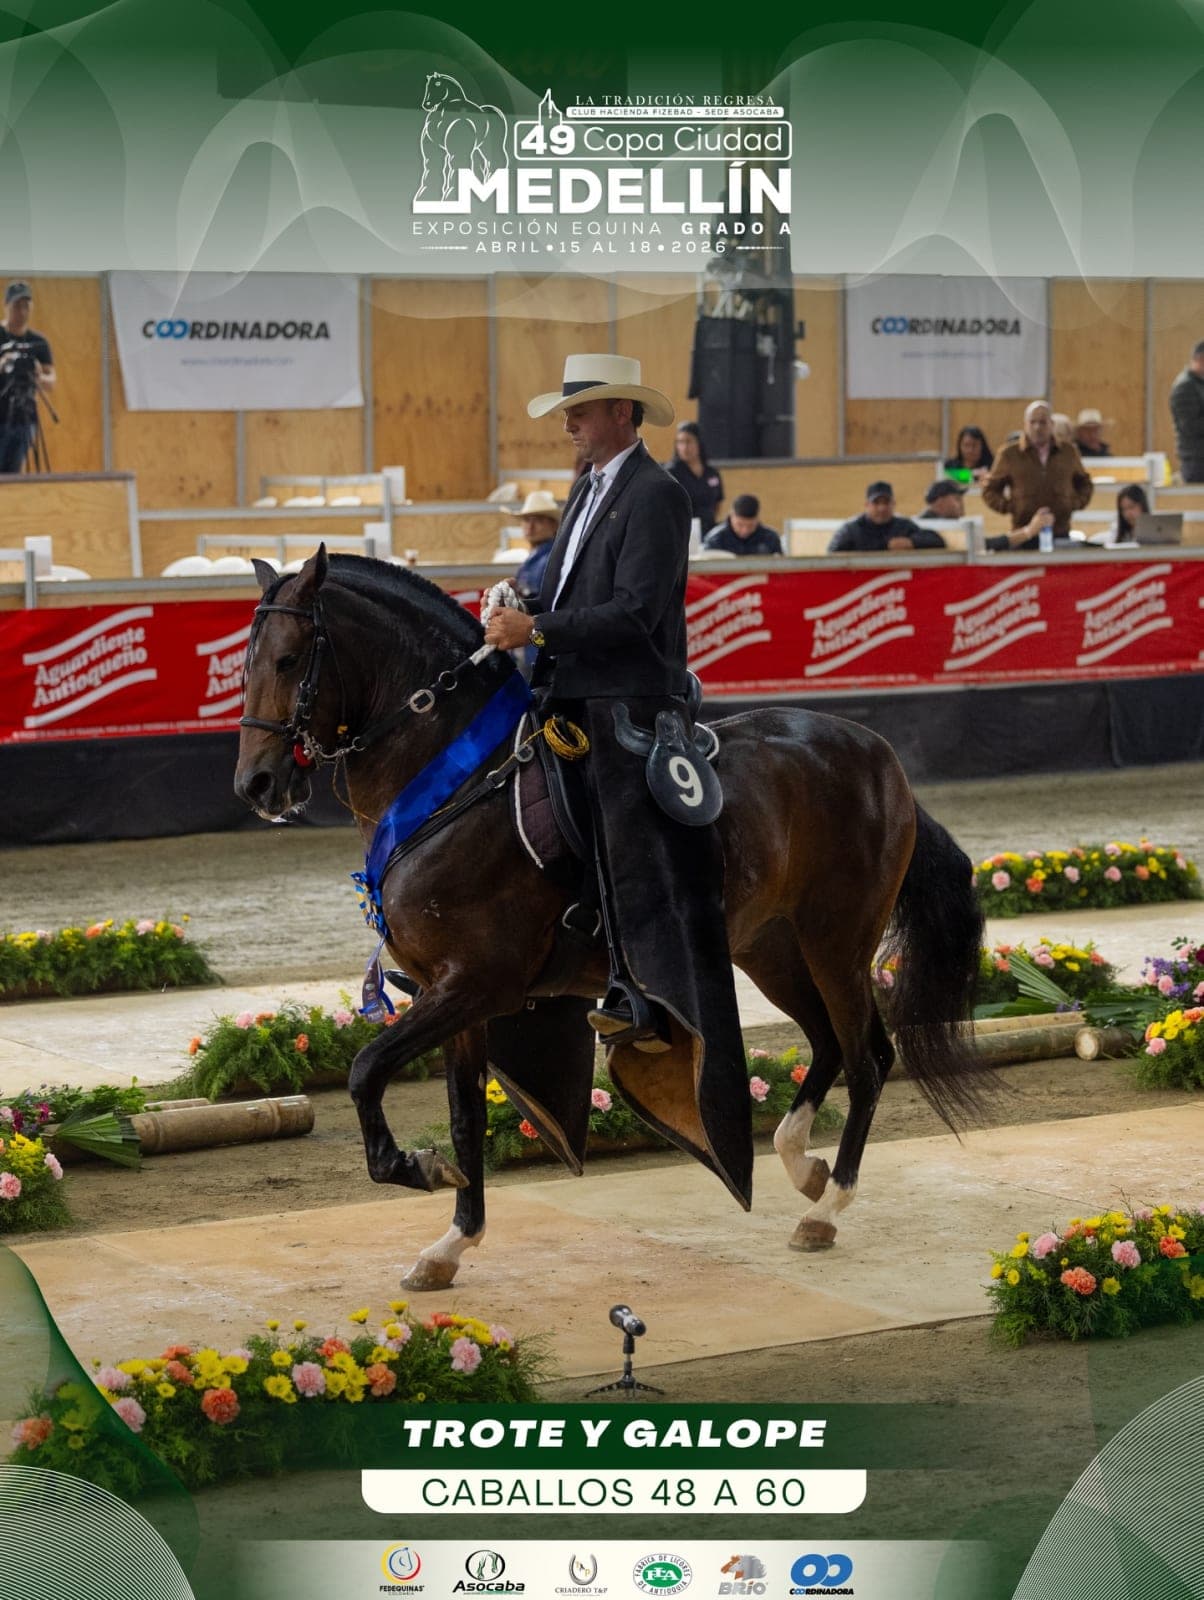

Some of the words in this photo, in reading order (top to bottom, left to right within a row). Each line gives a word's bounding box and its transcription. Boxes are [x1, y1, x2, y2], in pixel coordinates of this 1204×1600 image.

[142, 319, 331, 341] COORDINADORA
[871, 316, 1021, 337] COORDINADORA
[33, 644, 148, 709] Antioqueño
[34, 626, 146, 686] Aguardiente
[668, 755, 704, 807] 9
